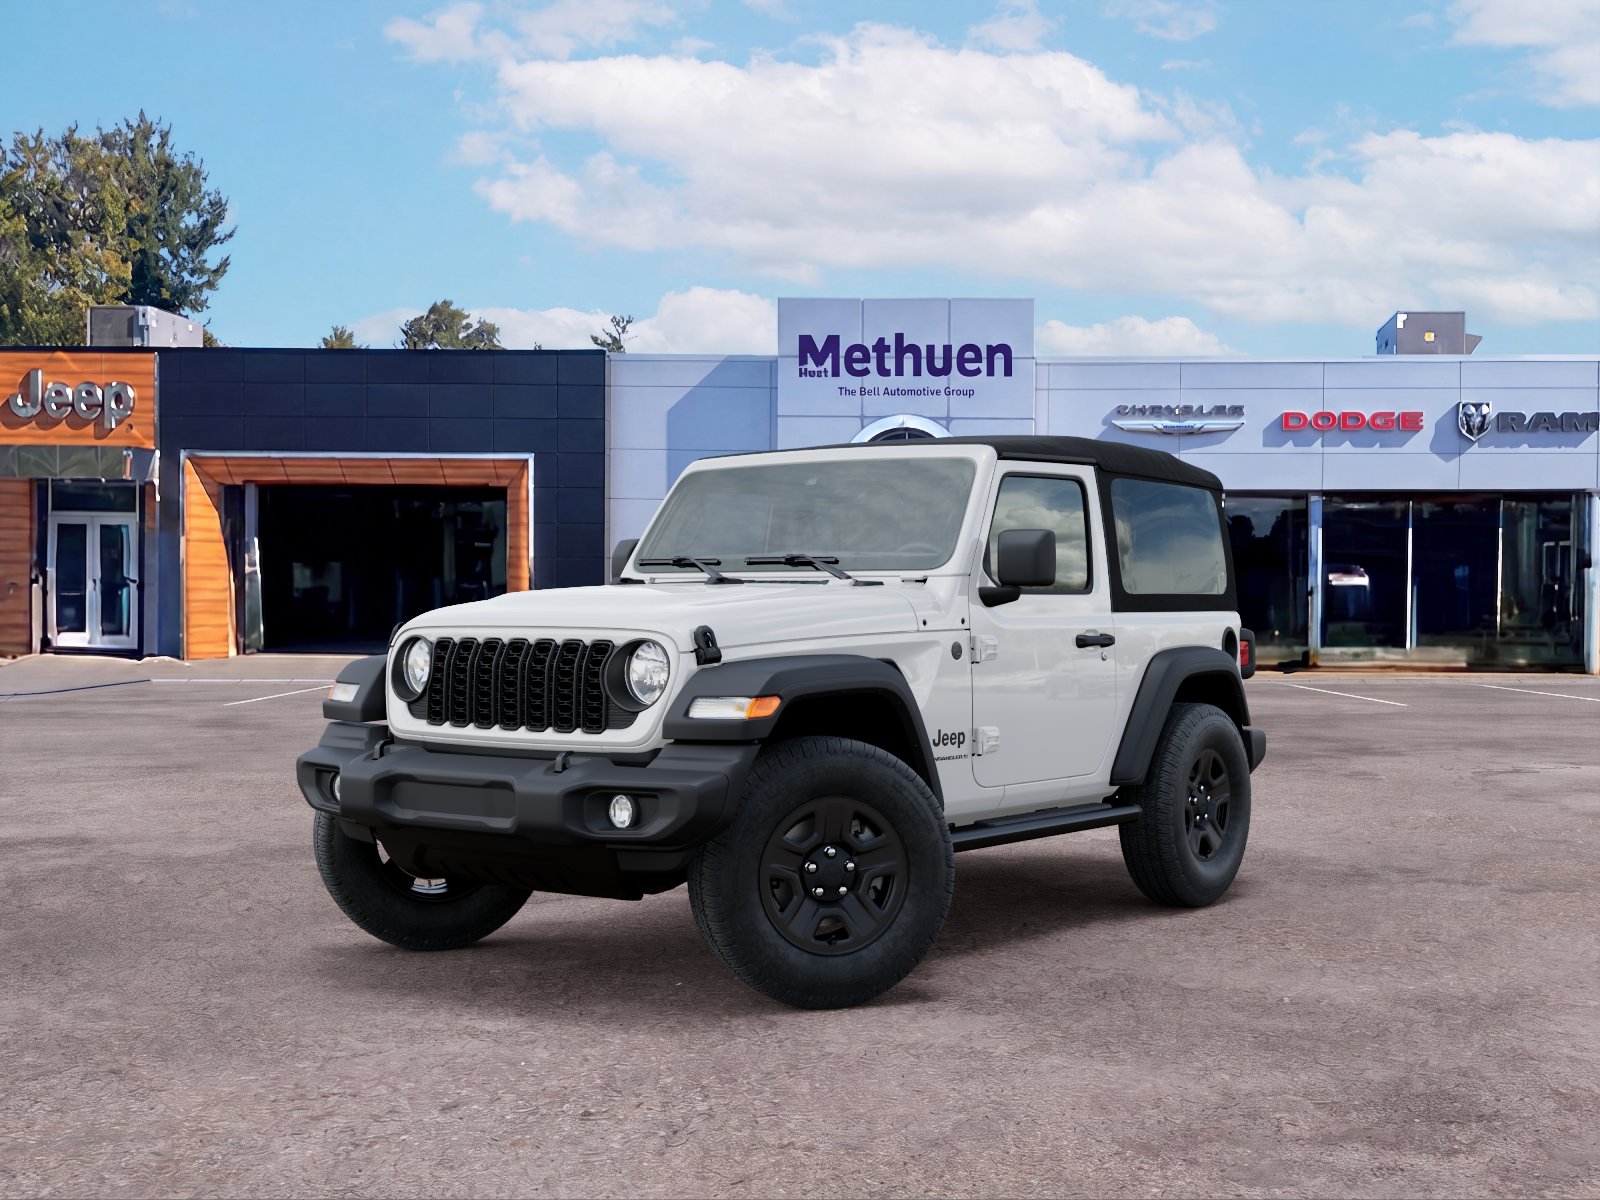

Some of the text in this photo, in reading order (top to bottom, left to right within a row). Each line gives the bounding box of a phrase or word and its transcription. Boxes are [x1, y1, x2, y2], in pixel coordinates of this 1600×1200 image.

[798, 332, 1013, 378] Methuen
[9, 368, 135, 429] Jeep
[838, 386, 975, 399] The Bell Automotive Group
[1282, 411, 1424, 431] DODGE
[1497, 411, 1599, 432] RAM
[932, 729, 966, 749] Jeep
